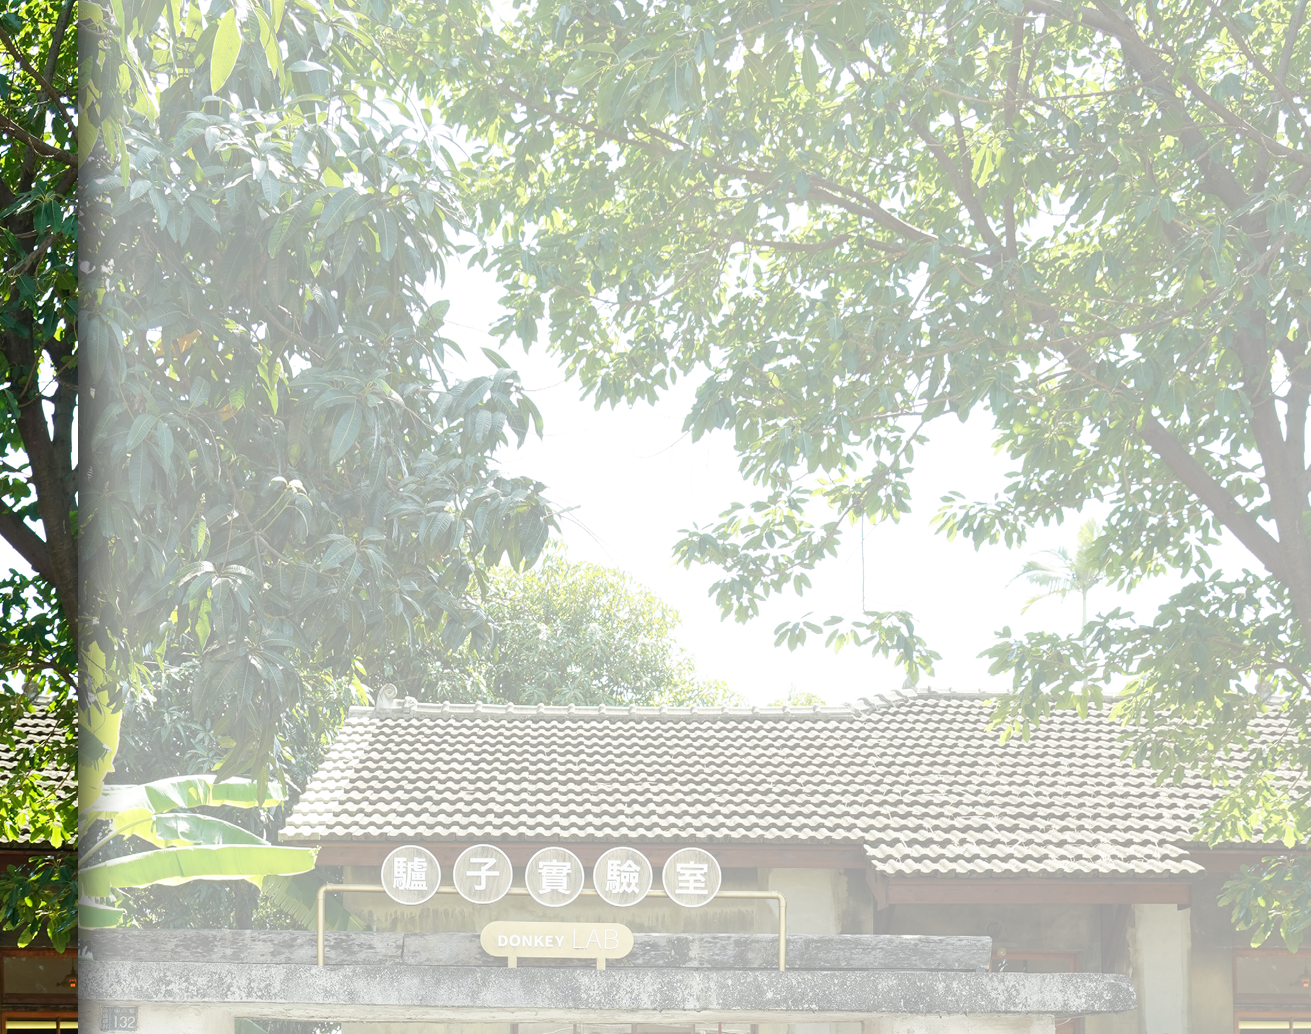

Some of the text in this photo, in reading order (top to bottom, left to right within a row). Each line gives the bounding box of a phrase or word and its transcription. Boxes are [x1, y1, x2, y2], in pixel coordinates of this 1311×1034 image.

[393, 857, 709, 895] 驢子實驗室
[497, 928, 620, 950] DONKEY LAB
[114, 1015, 136, 1029] 132
